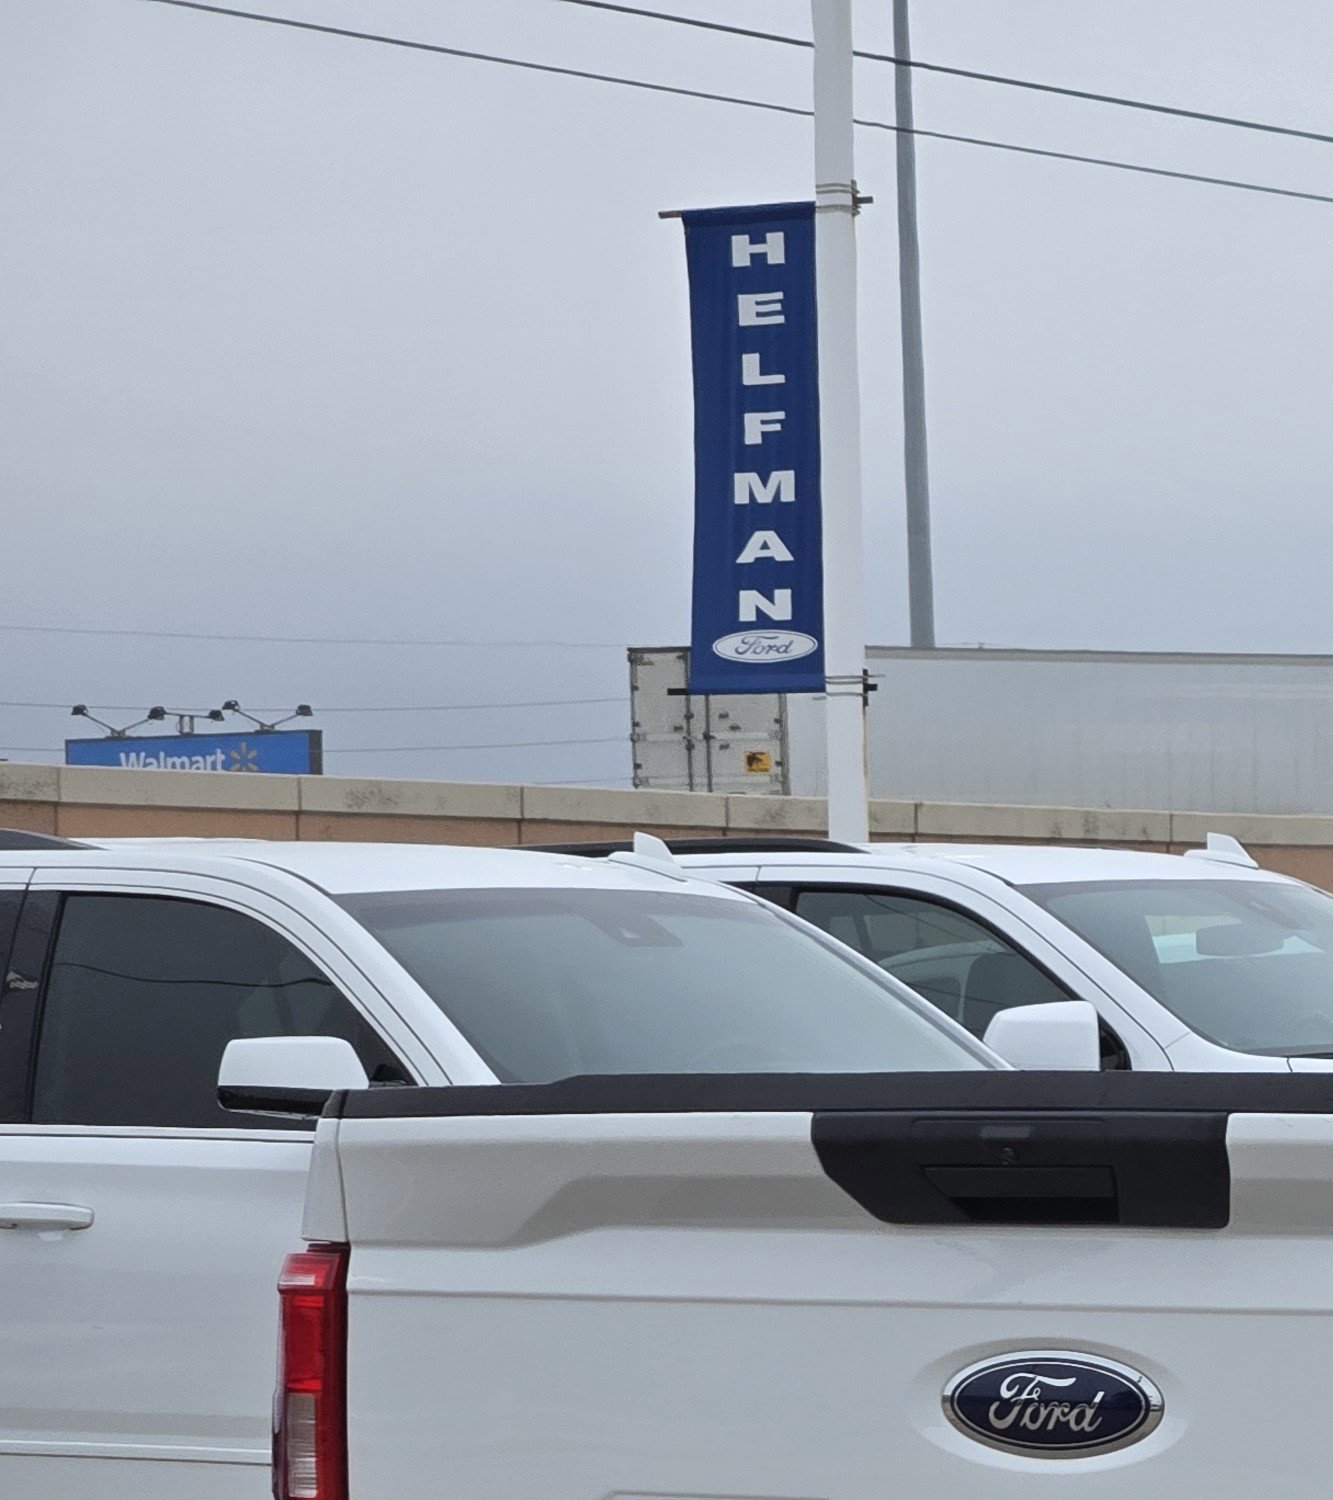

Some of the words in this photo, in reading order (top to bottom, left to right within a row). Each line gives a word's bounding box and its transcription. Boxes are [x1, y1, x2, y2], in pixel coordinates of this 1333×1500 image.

[731, 231, 796, 622] HELFMAN
[734, 635, 794, 656] Ford
[119, 748, 226, 771] Walmart
[988, 1372, 1105, 1432] Ford
